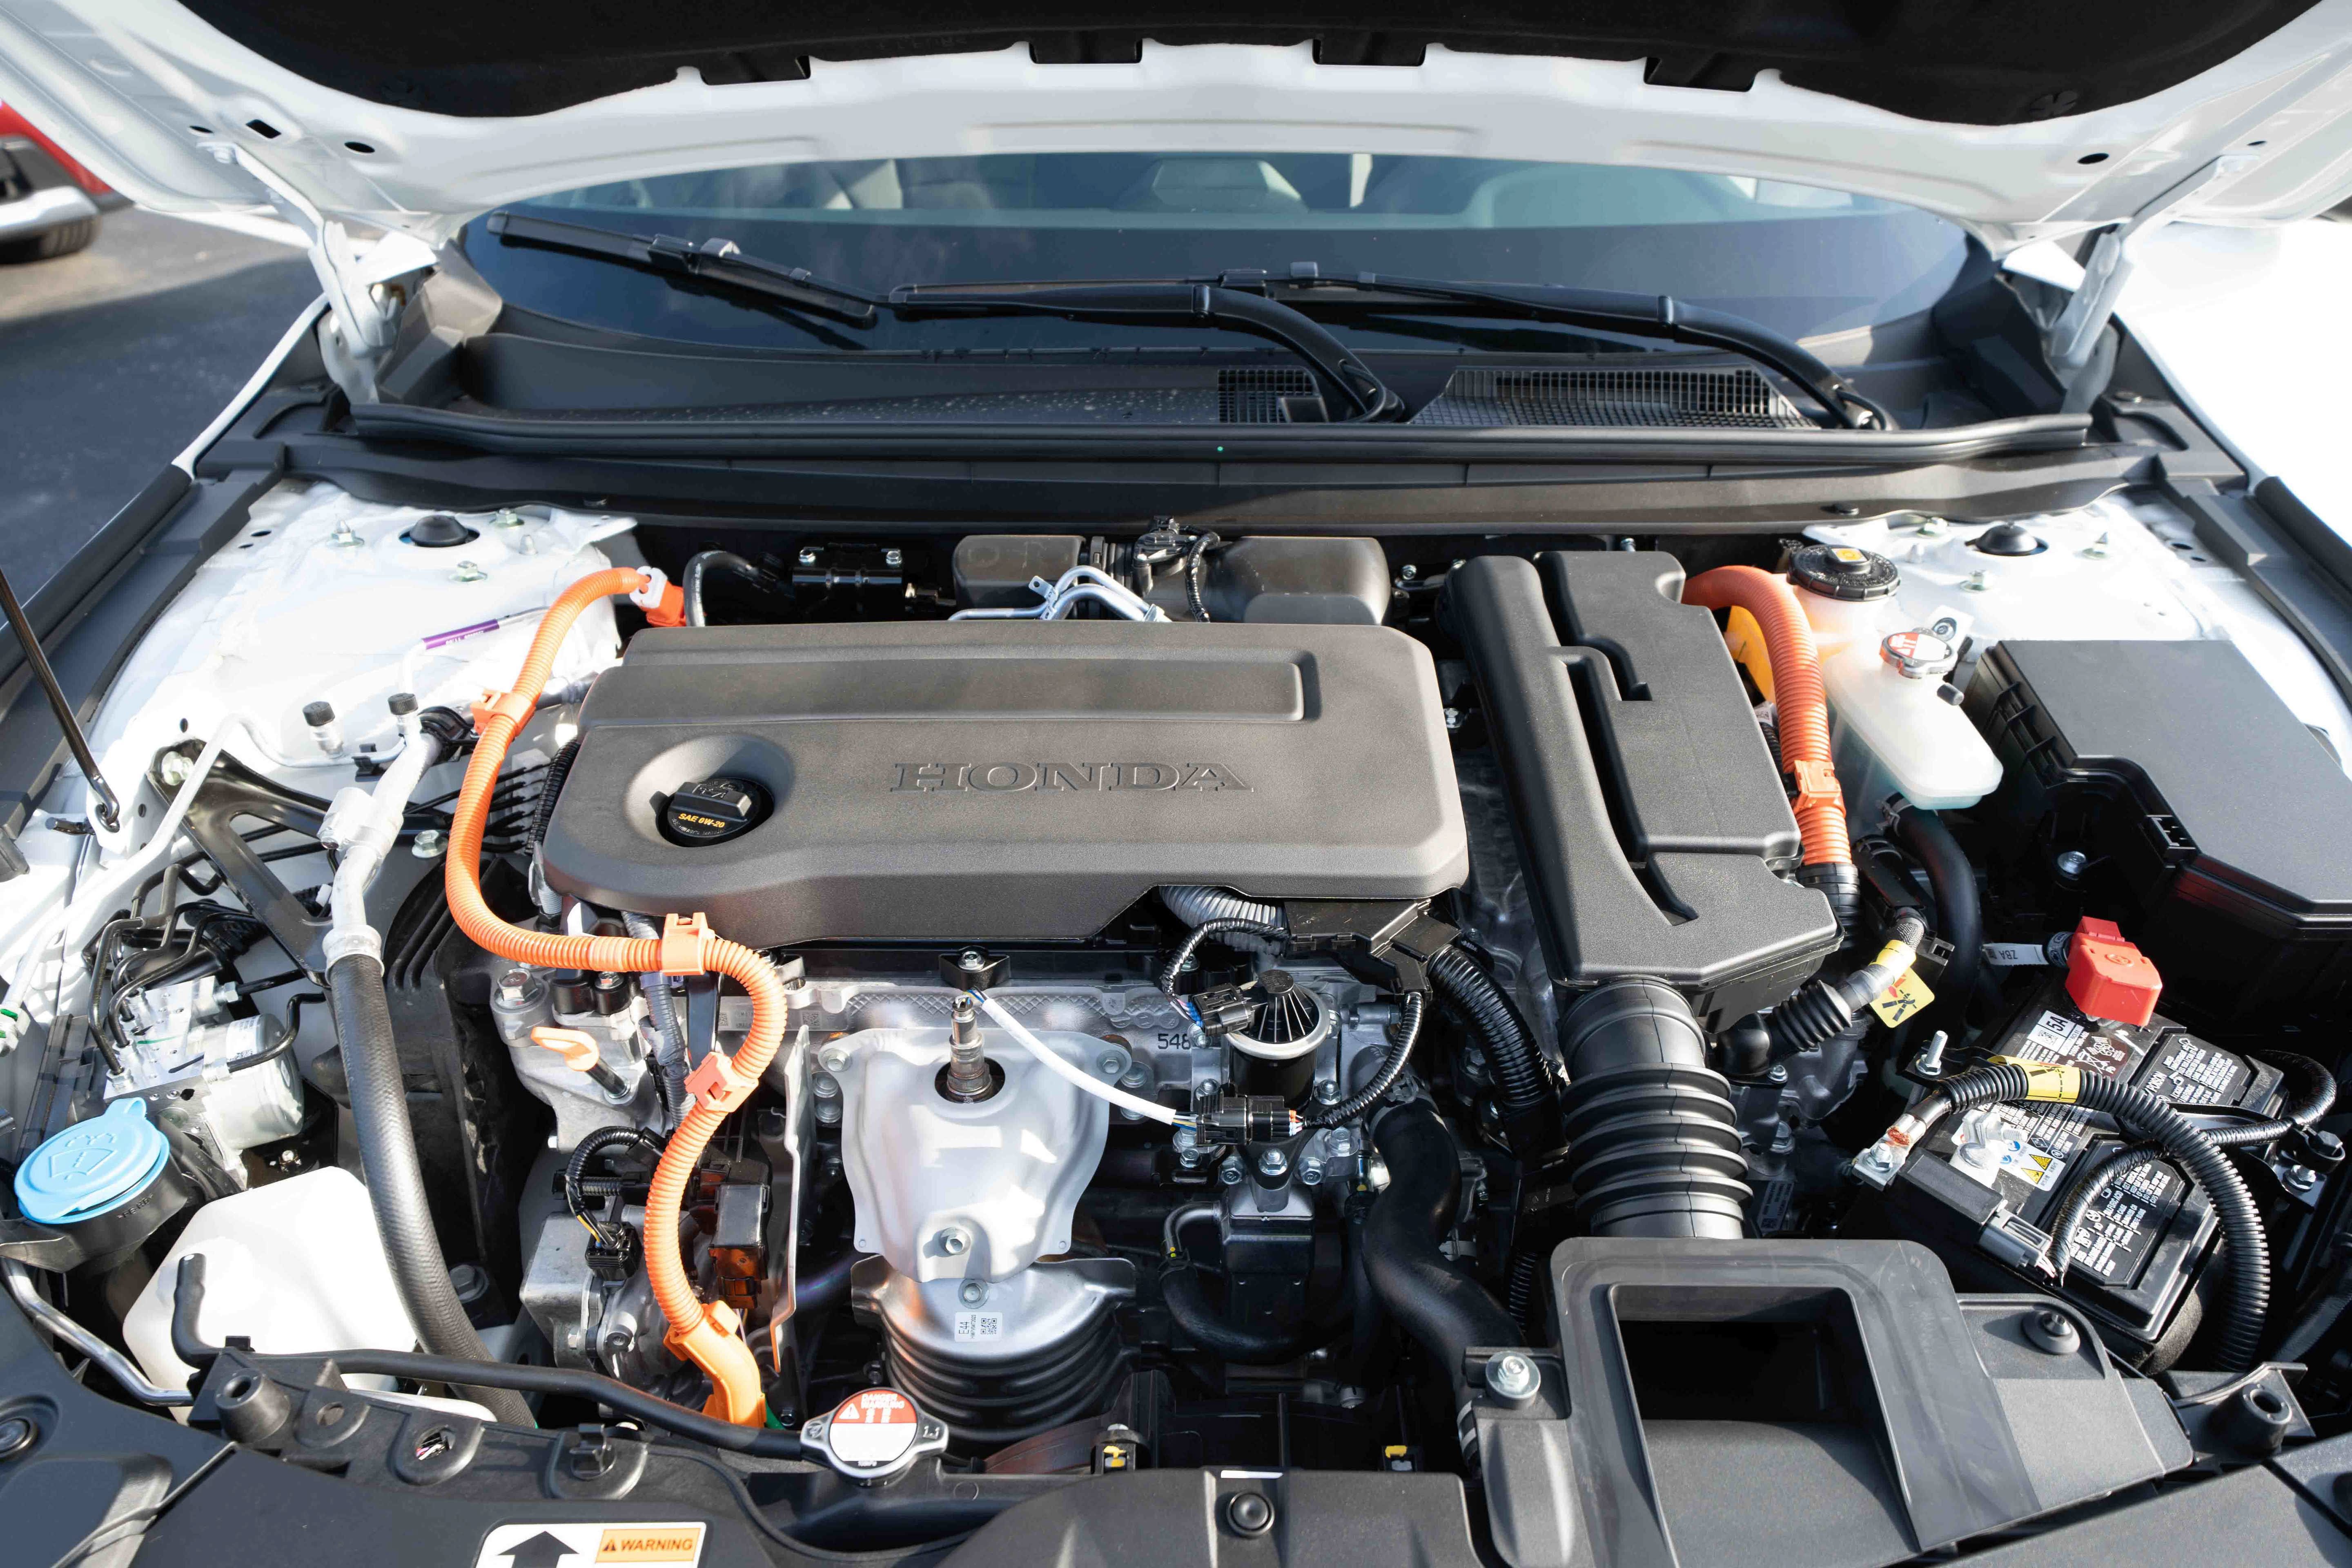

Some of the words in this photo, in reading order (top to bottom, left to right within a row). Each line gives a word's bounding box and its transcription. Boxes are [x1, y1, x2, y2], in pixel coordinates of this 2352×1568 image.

[890, 762, 1254, 792] HONDA
[678, 813, 698, 823] SAE
[698, 817, 725, 828] 0W-20
[2046, 1016, 2068, 1031] 5A
[959, 1322, 969, 1334] E44
[621, 1538, 693, 1550] WARNING
